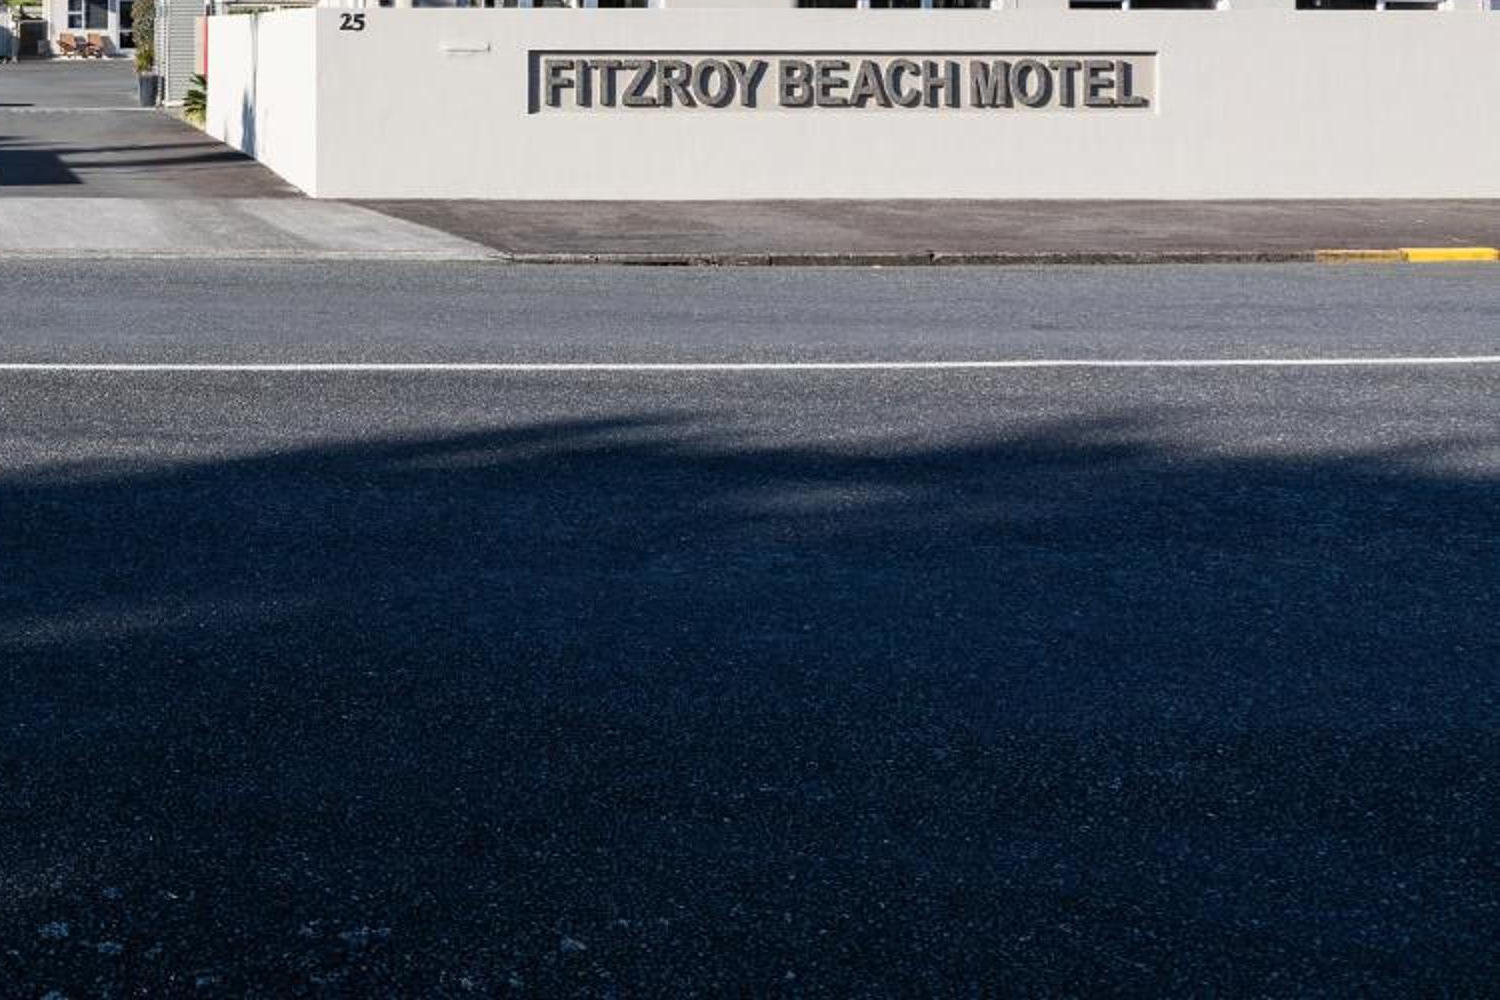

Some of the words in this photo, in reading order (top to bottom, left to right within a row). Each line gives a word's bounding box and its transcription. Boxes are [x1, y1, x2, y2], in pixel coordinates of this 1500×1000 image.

[340, 13, 365, 30] 25
[545, 58, 768, 107] FITZROY
[779, 59, 961, 108] BEACH
[970, 59, 1149, 108] MOTEL
